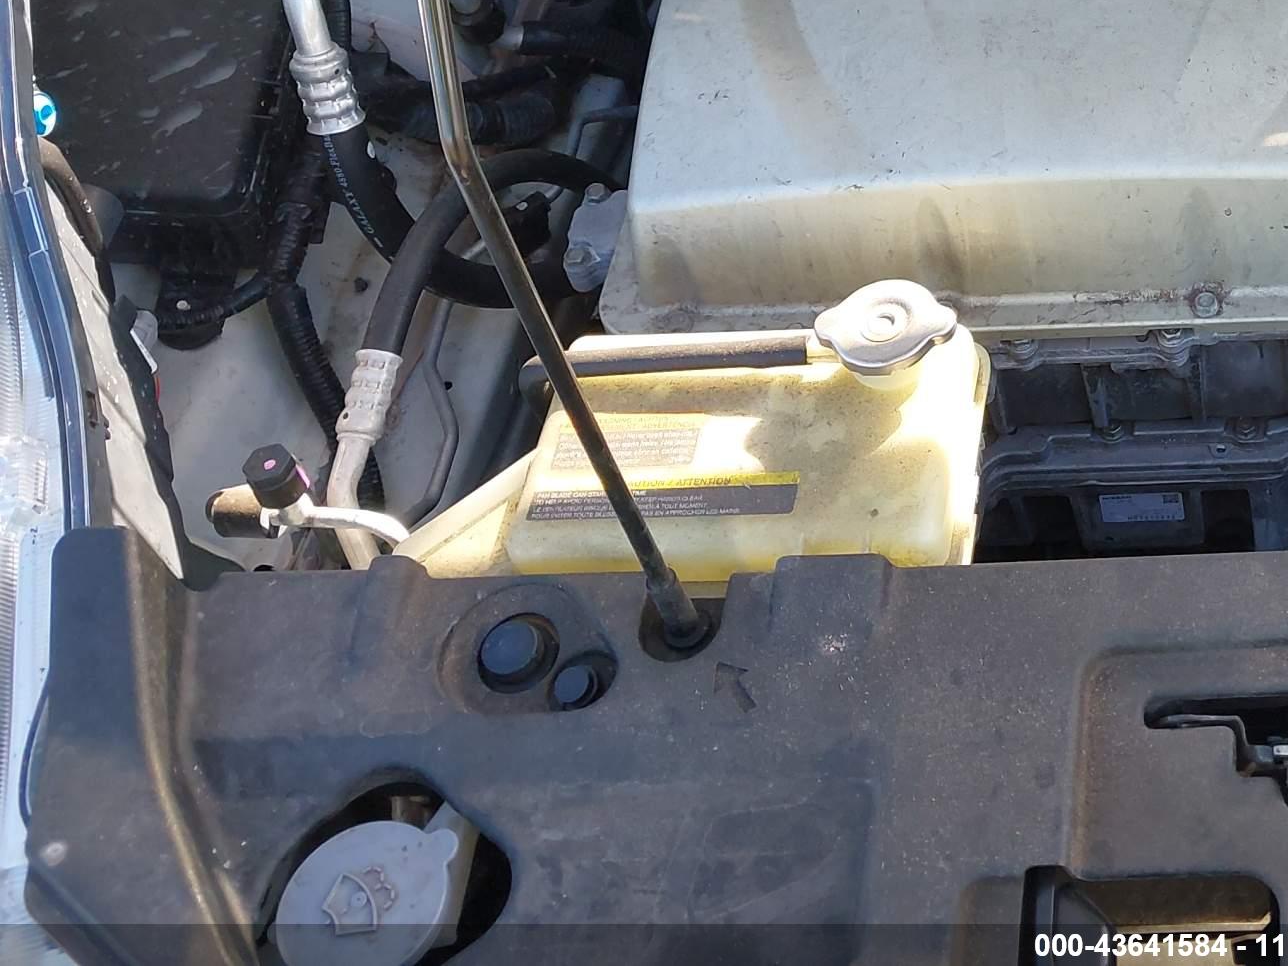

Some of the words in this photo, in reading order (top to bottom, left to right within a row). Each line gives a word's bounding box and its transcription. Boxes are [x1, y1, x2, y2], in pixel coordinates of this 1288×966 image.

[345, 192, 375, 234] GALAXY
[629, 479, 664, 487] AUTION
[675, 477, 731, 486] ATTENTION
